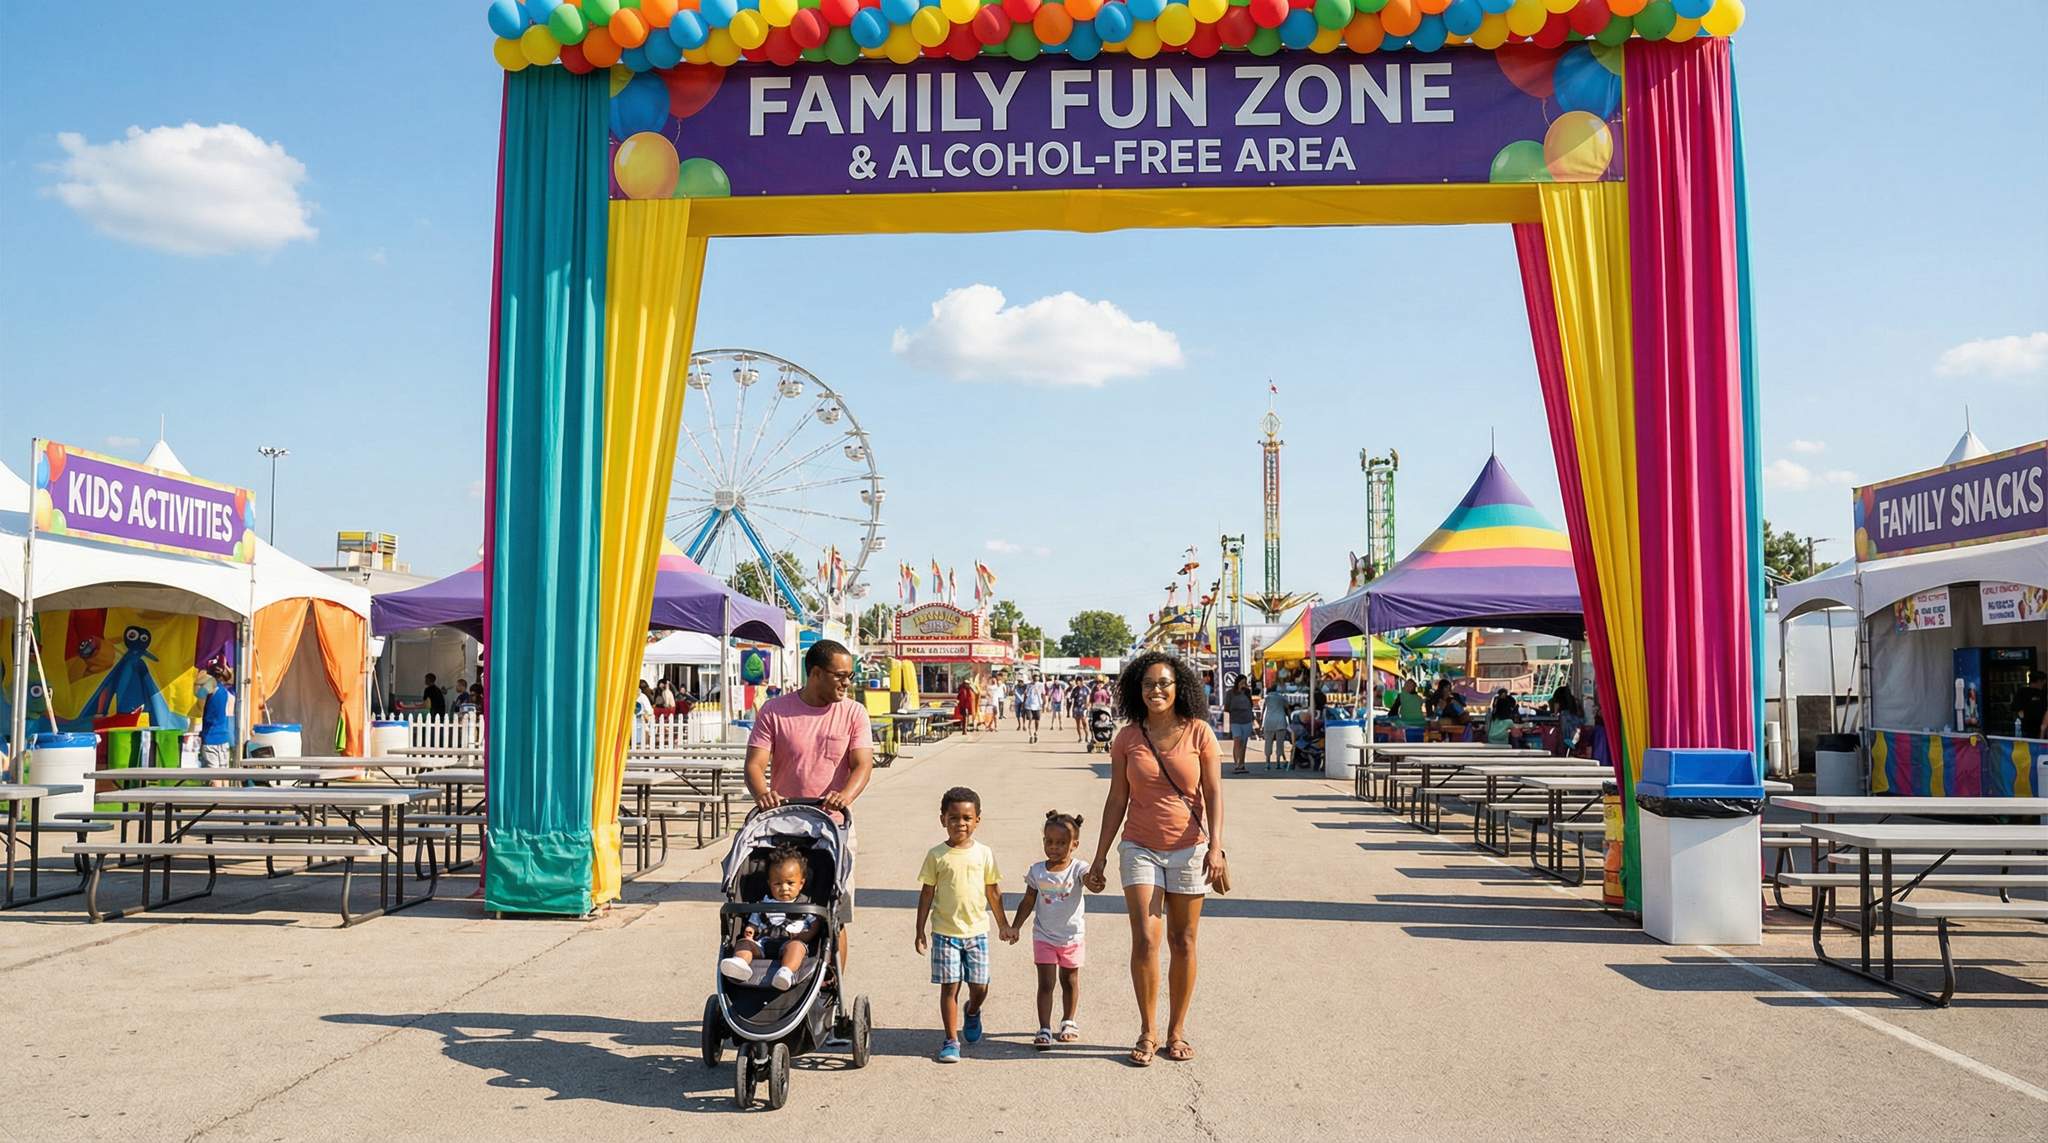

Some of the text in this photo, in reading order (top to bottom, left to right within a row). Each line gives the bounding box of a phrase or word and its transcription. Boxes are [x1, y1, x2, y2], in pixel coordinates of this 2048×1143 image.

[749, 62, 1454, 136] FAMILY FUN ZONE
[848, 136, 1357, 180] & ALCOHOL-FREE AREA
[68, 470, 233, 543] KIDS ACTIVITIES
[1879, 466, 2044, 539] FAMILY SNACKS
